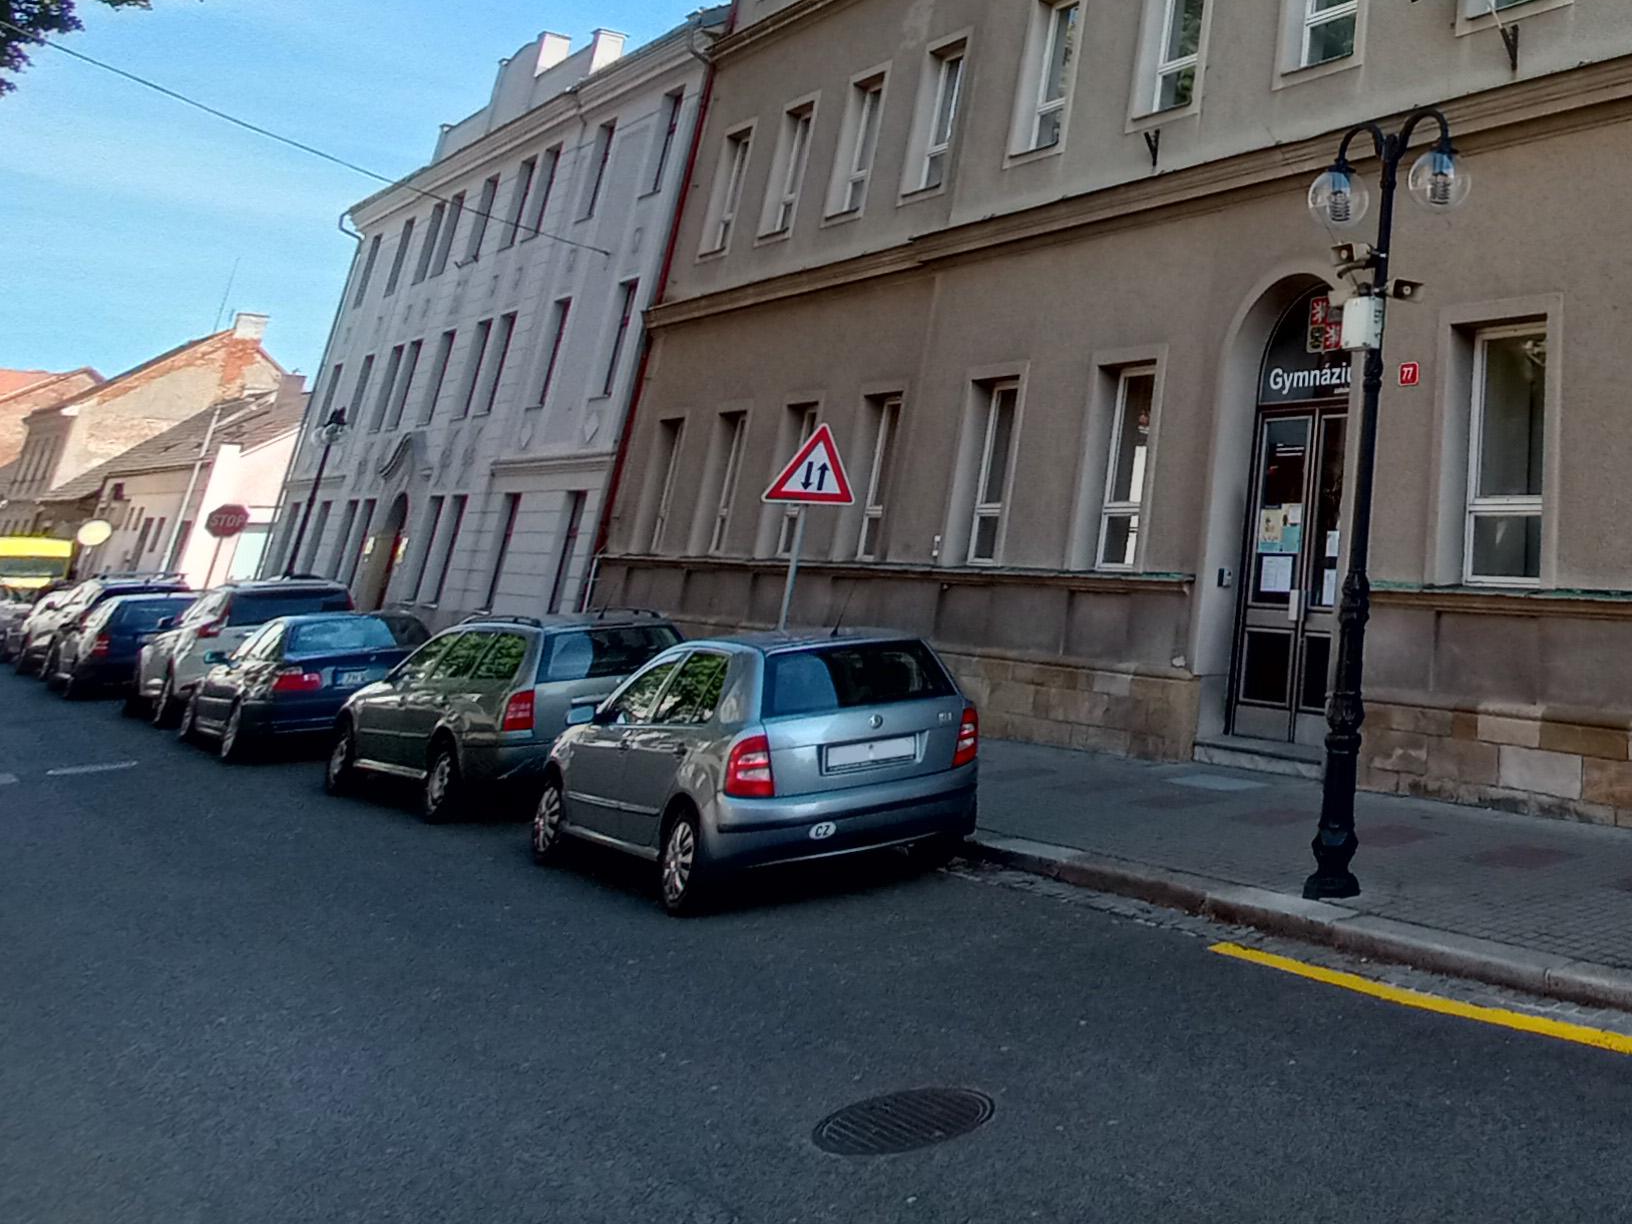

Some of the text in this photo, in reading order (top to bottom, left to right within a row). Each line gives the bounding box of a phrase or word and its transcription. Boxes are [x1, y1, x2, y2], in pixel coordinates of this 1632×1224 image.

[1402, 367, 1414, 381] 77
[209, 513, 246, 528] STOP
[814, 824, 831, 838] CZ
